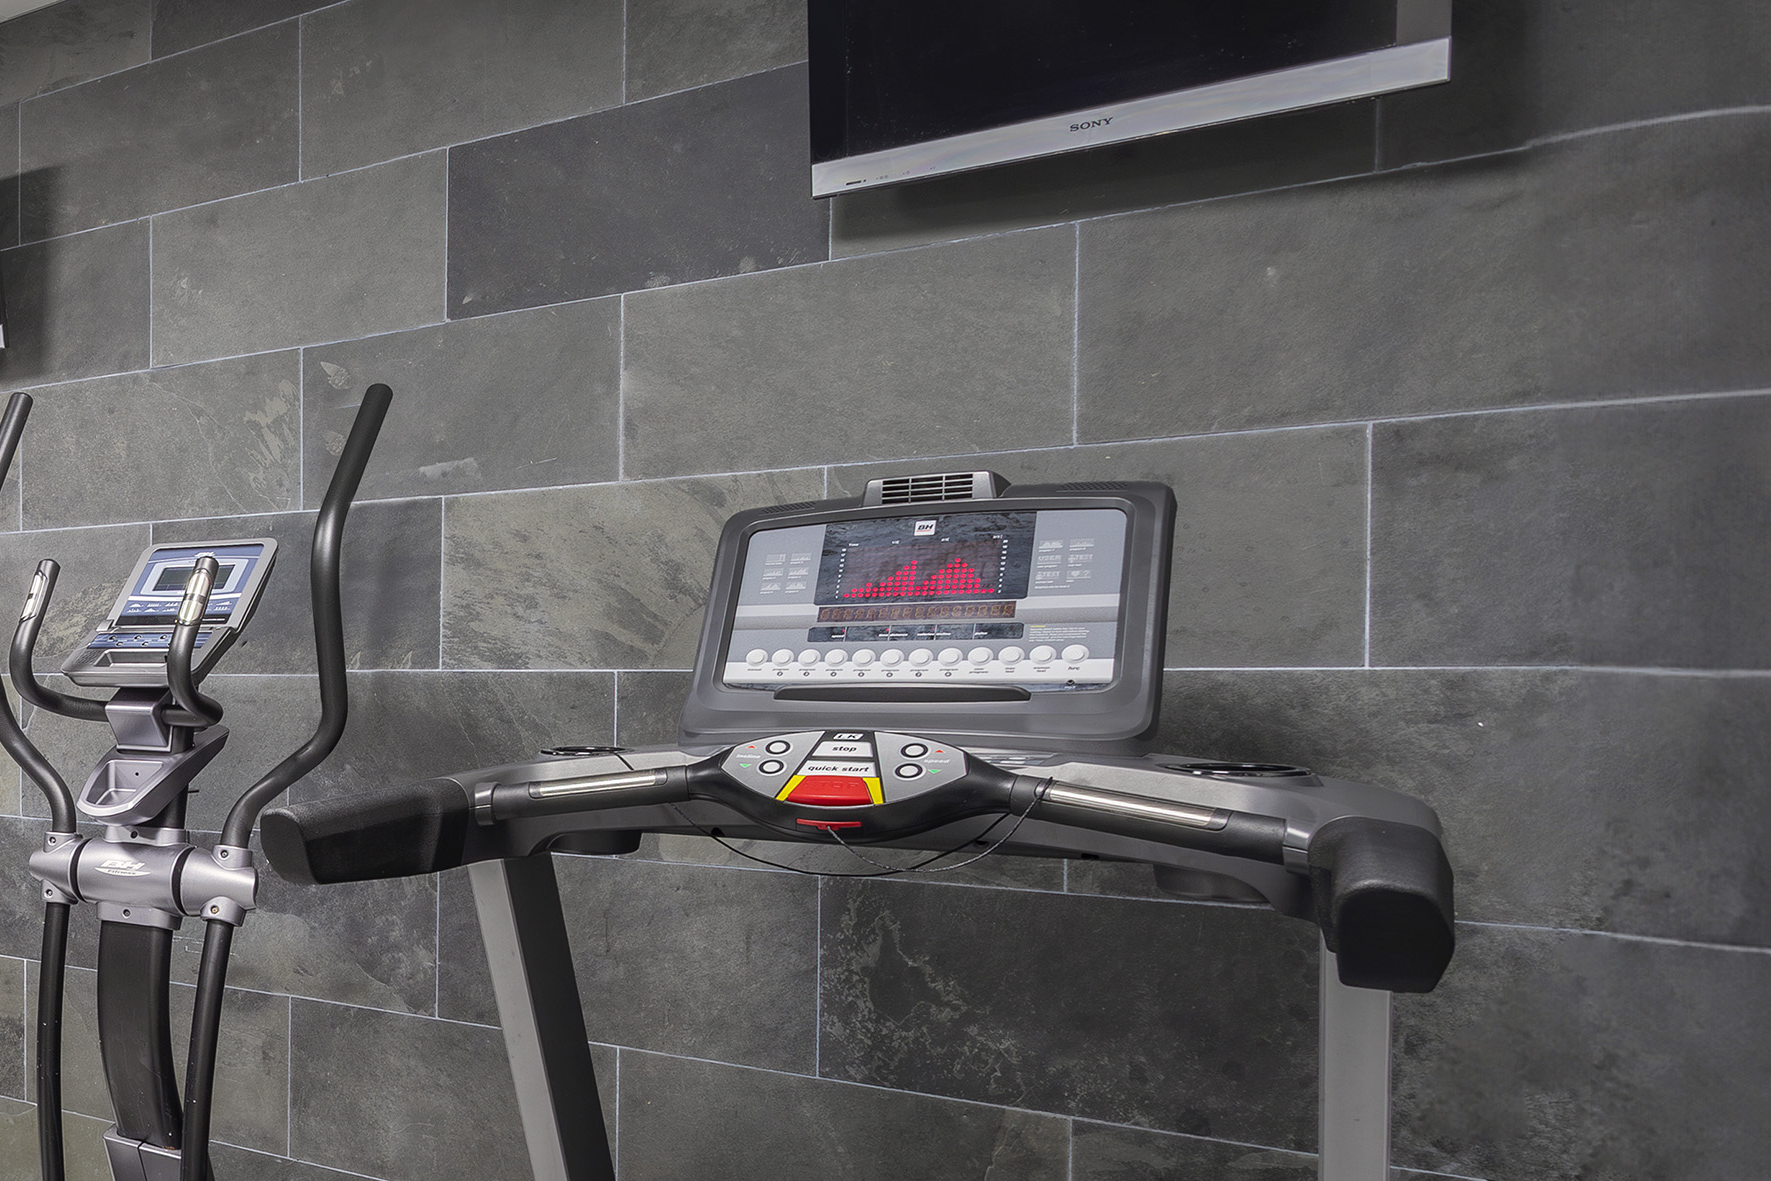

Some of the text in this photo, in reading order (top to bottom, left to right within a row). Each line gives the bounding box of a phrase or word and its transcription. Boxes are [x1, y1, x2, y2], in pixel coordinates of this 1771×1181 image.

[1069, 117, 1114, 132] SONY
[917, 523, 934, 531] BH
[100, 859, 146, 871] BH
